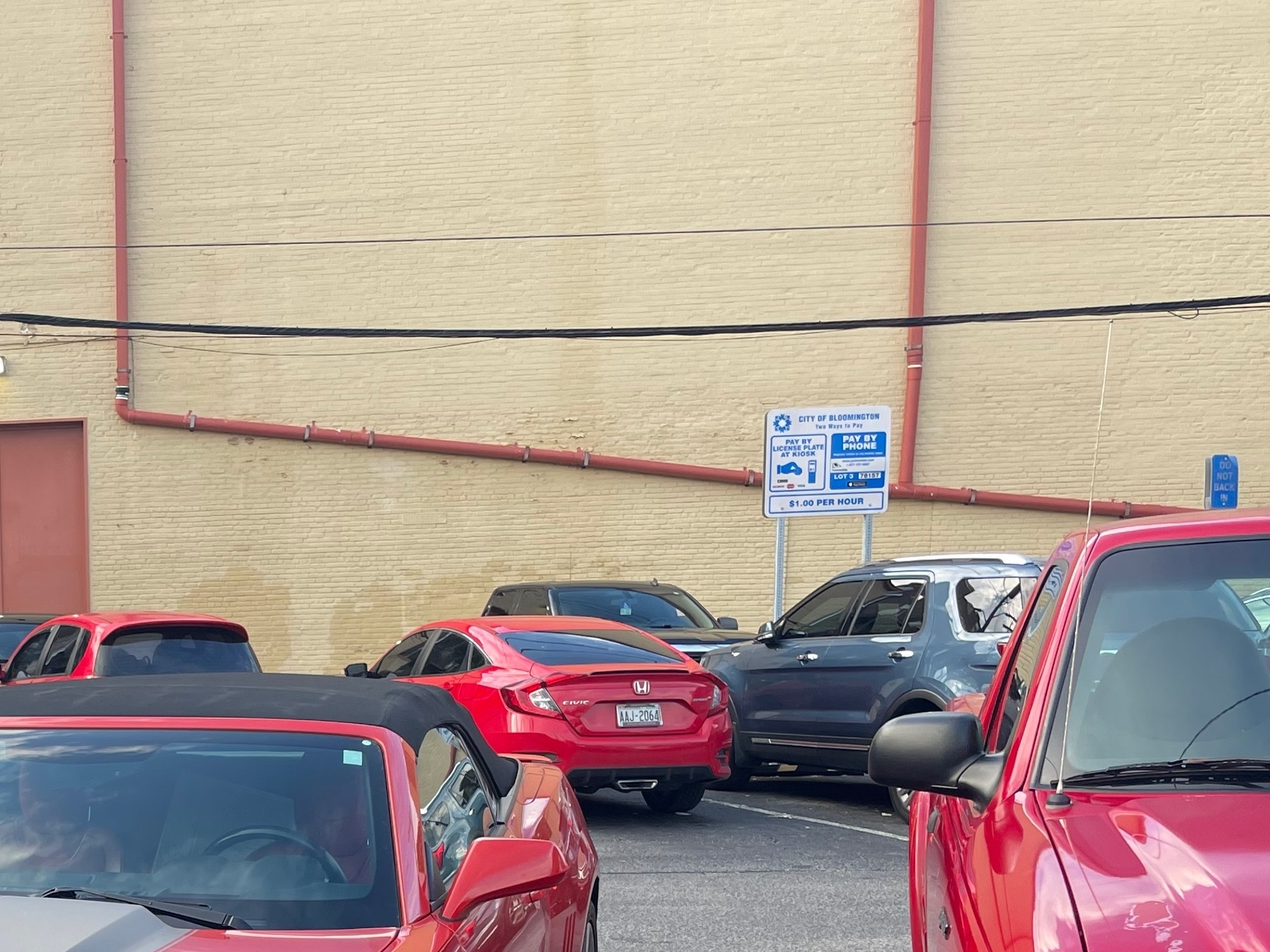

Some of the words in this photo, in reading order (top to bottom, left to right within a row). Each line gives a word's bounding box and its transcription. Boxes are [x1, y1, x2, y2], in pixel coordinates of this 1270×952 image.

[798, 415, 815, 423] CITY
[817, 414, 827, 422] OF
[828, 413, 880, 422] BLOOMINGTON
[852, 422, 863, 430] Pay
[864, 434, 878, 442] BY
[842, 442, 877, 450] PHONE
[1219, 461, 1231, 469] DO
[1216, 472, 1233, 480] NOT
[1213, 483, 1235, 491] BACK
[1220, 493, 1228, 502] IN
[816, 499, 835, 507] PER
[837, 498, 864, 506] HOUR
[619, 709, 660, 722] AAJ-2064
